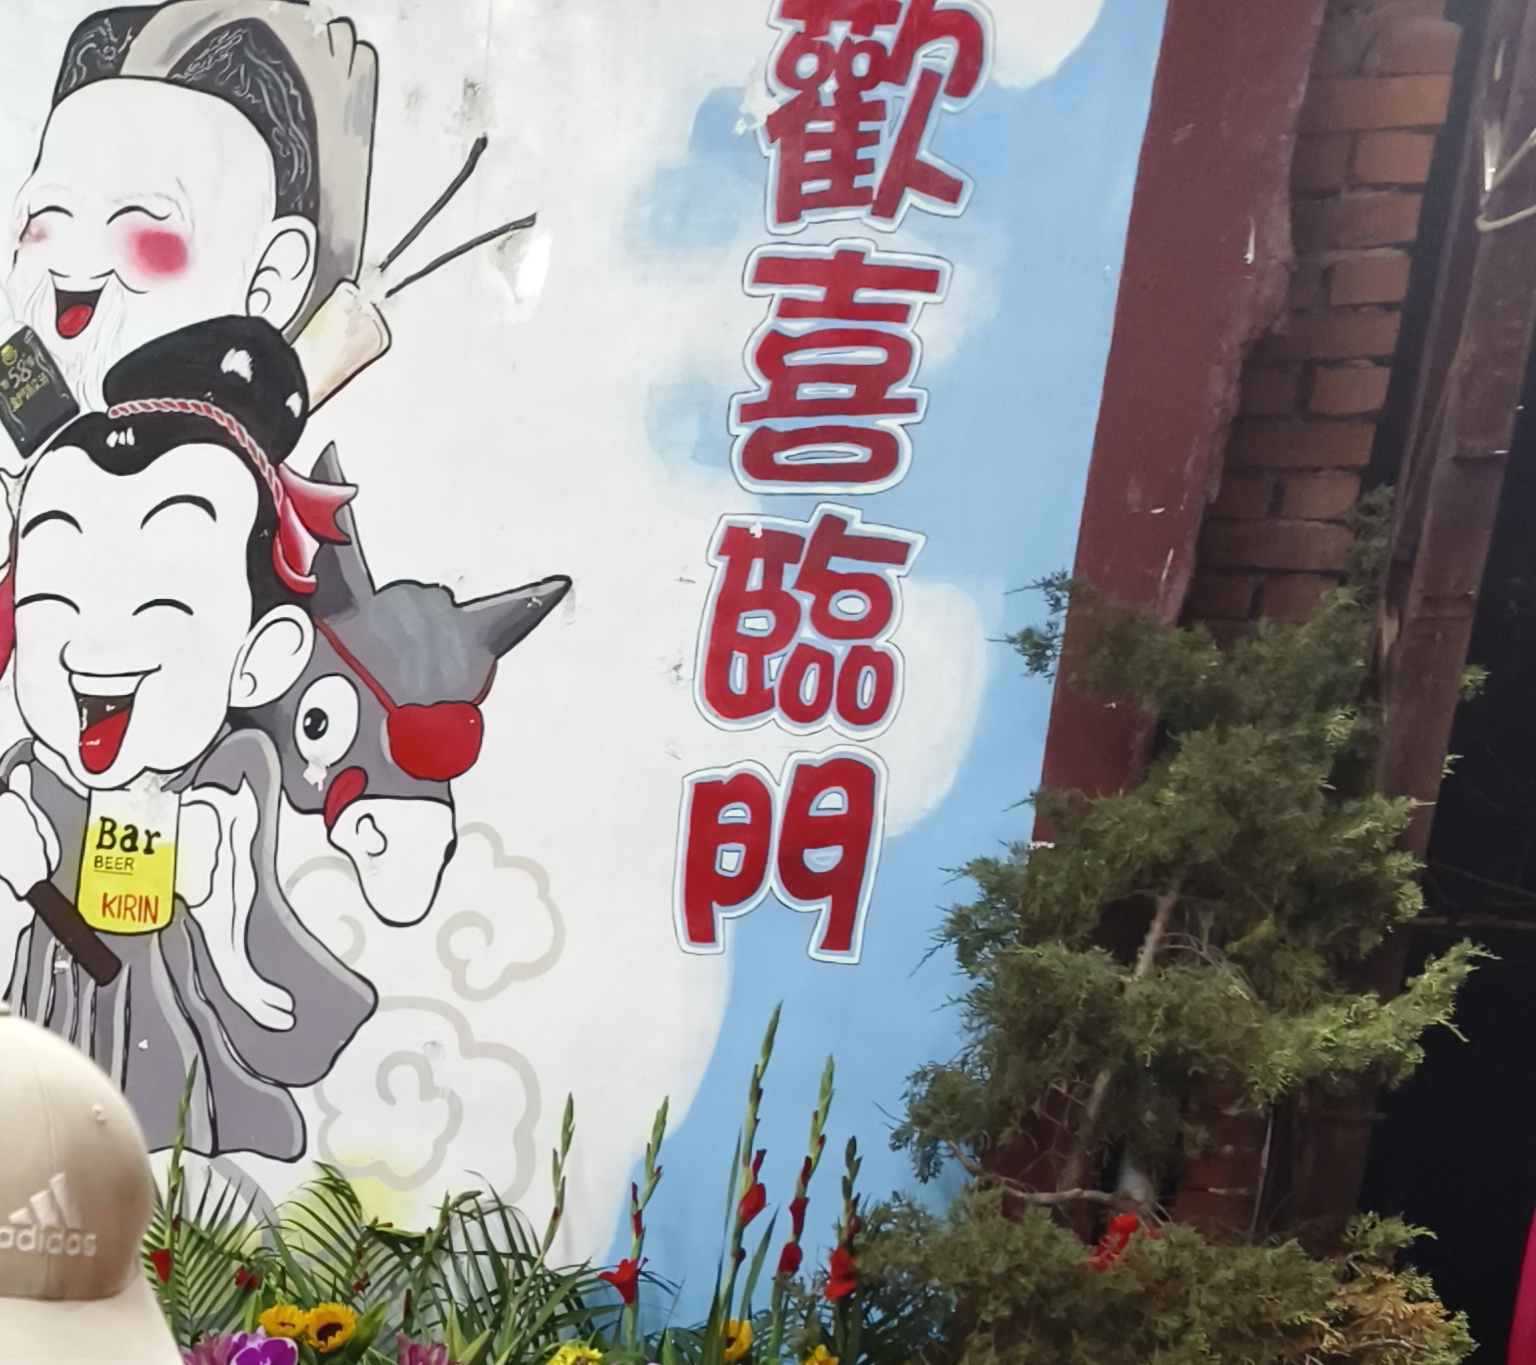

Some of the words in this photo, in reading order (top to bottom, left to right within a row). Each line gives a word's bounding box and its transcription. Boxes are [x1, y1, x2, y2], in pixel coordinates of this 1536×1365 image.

[673, 0, 992, 964] 歡喜臨門
[95, 816, 161, 855] Bar
[94, 855, 134, 871] BEER
[102, 892, 159, 925] KIRIN
